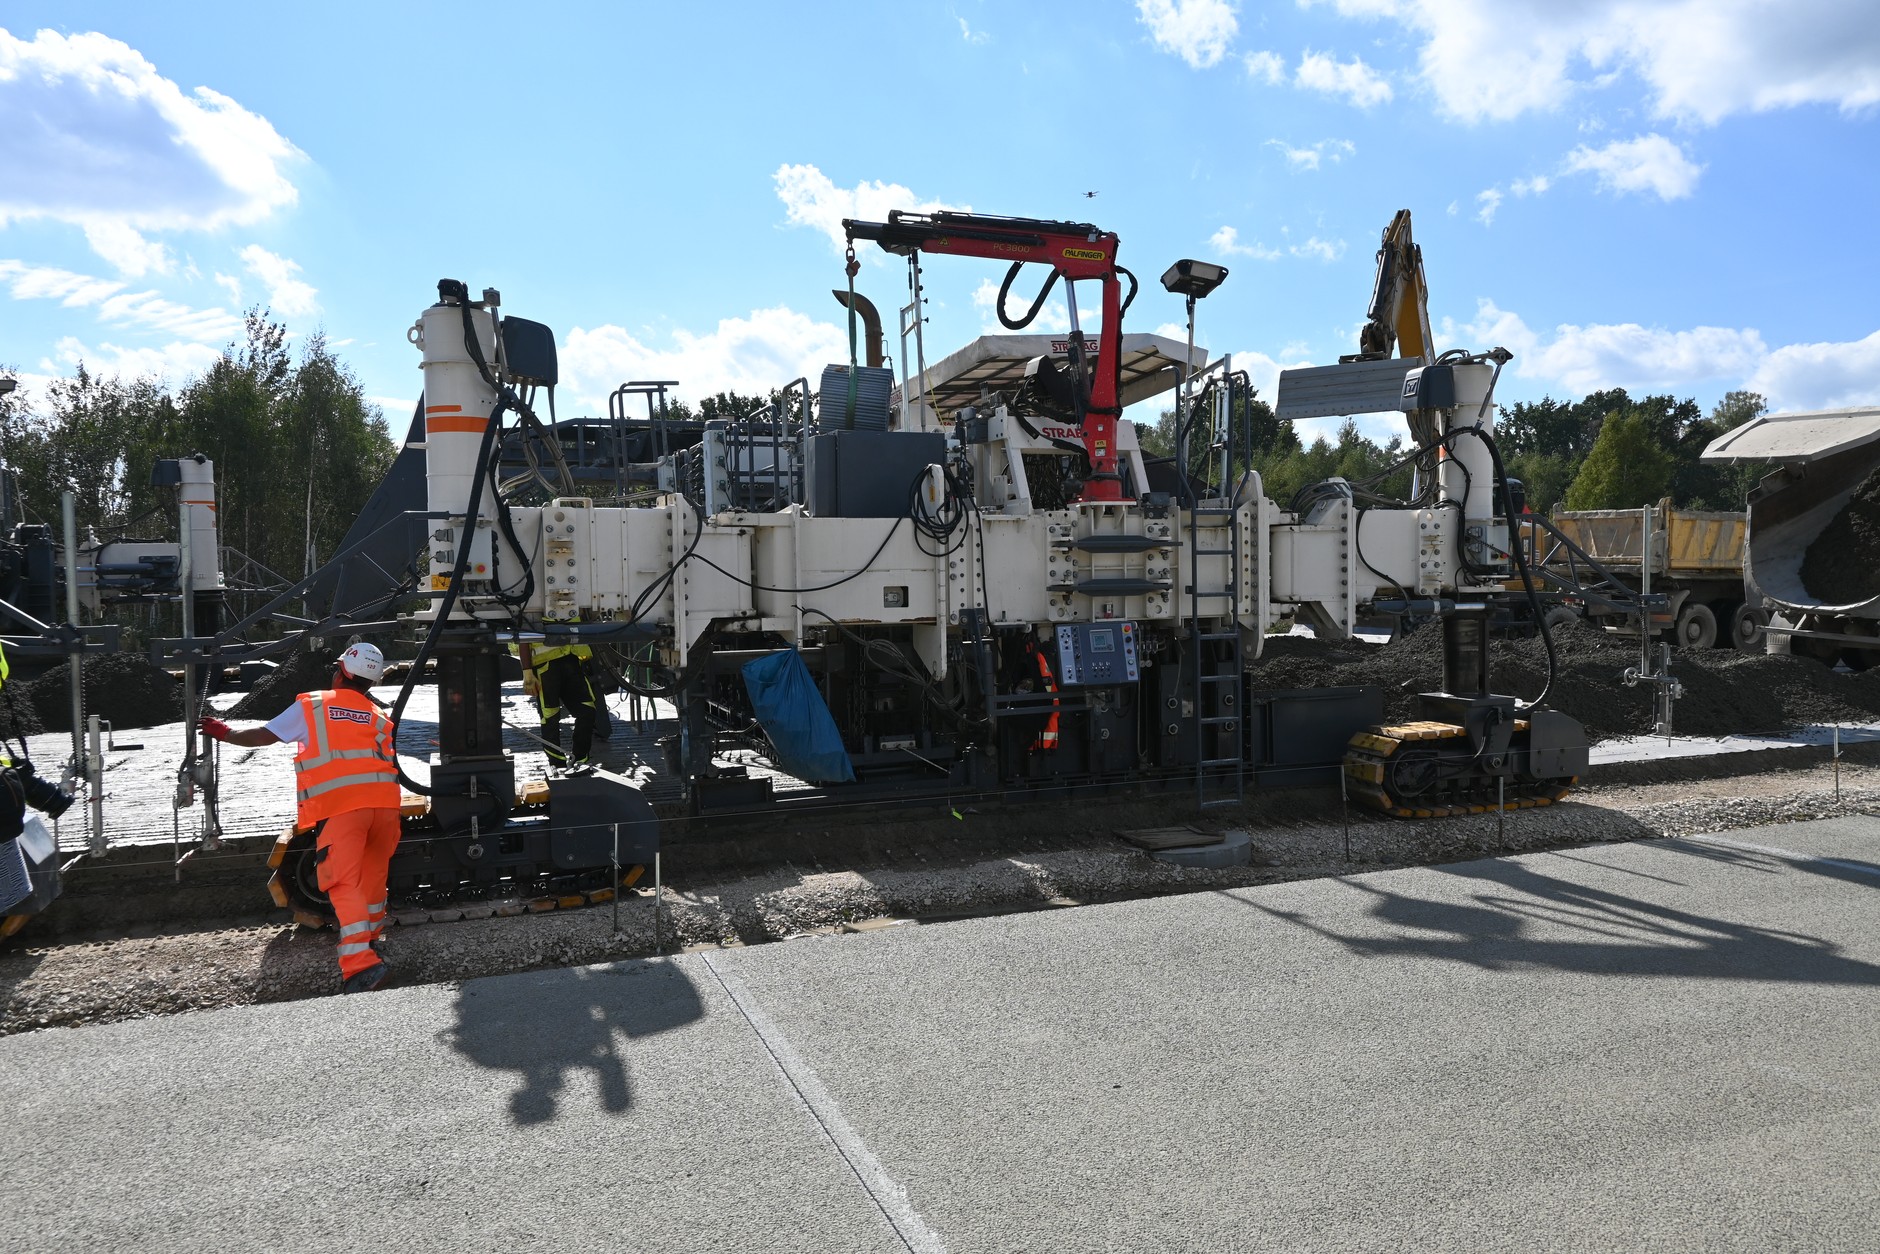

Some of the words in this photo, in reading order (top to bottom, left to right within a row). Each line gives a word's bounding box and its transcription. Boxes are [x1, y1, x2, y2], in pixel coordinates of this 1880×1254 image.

[993, 243, 1003, 251] PC
[1006, 244, 1031, 253] 3800
[1064, 249, 1103, 259] PALFINGER
[1051, 341, 1098, 351] STRAG
[329, 709, 371, 722] STRABAG
